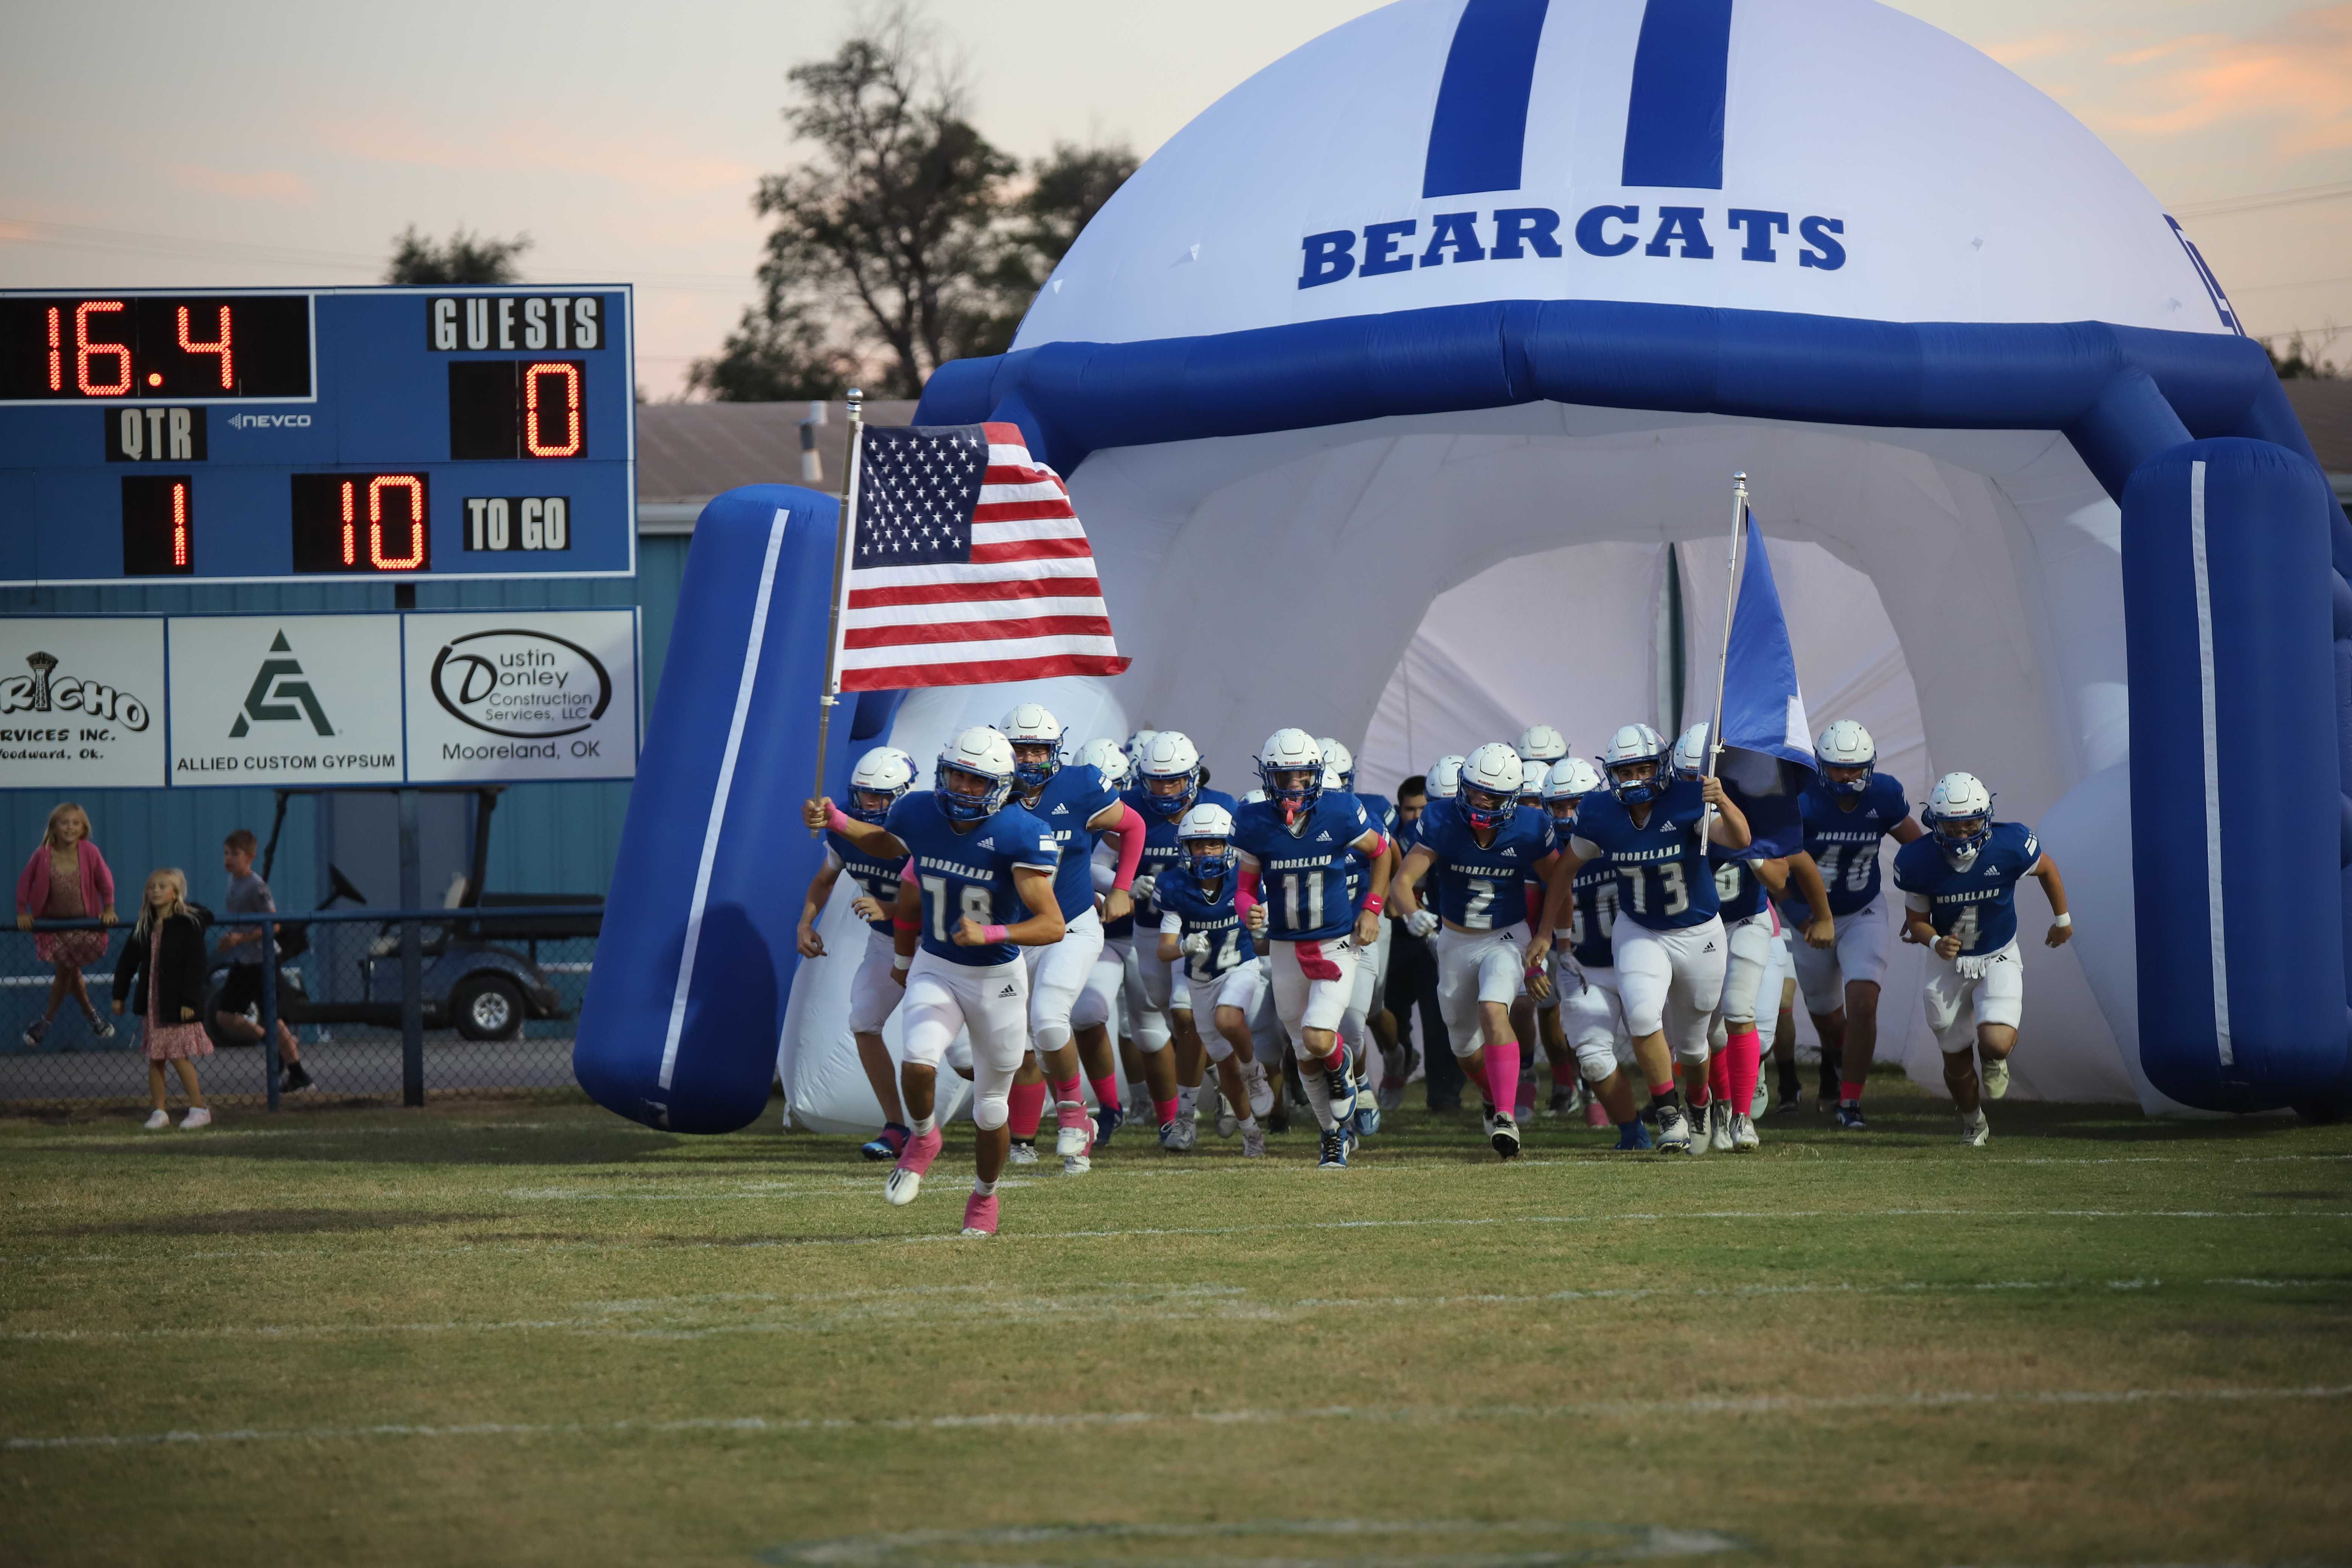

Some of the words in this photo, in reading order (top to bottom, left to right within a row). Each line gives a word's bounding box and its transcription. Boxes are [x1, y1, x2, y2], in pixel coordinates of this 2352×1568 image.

[1298, 205, 1846, 290] BEARCATS
[434, 297, 598, 351] GUESTS
[49, 302, 232, 395] 16.4
[527, 363, 579, 456] 0
[121, 408, 191, 461] QTR
[174, 484, 185, 565] 1
[343, 476, 423, 569] 10
[468, 498, 509, 550] TO
[521, 498, 565, 550] GO
[489, 692, 593, 706] Construction
[485, 708, 555, 721] Services,
[562, 707, 587, 719] LLC
[80, 729, 116, 741] INC.
[0, 749, 71, 759] oodward,
[177, 757, 238, 770] ALLIED
[244, 756, 316, 770] CUSTOM
[322, 755, 395, 768] GYPSUM
[443, 742, 560, 760] Mooreland,
[571, 741, 600, 757] OK
[1271, 854, 1332, 869] MOORELAND
[1611, 844, 1681, 861] MOORELAND
[920, 856, 994, 881] MOORELAND
[1450, 864, 1514, 876] MOORELAND
[1282, 871, 1324, 931] 11
[1464, 878, 1495, 930] 2
[1936, 888, 2000, 903] MOORELAND
[1189, 914, 1239, 929] MOORELAND
[1950, 905, 1983, 950] 4
